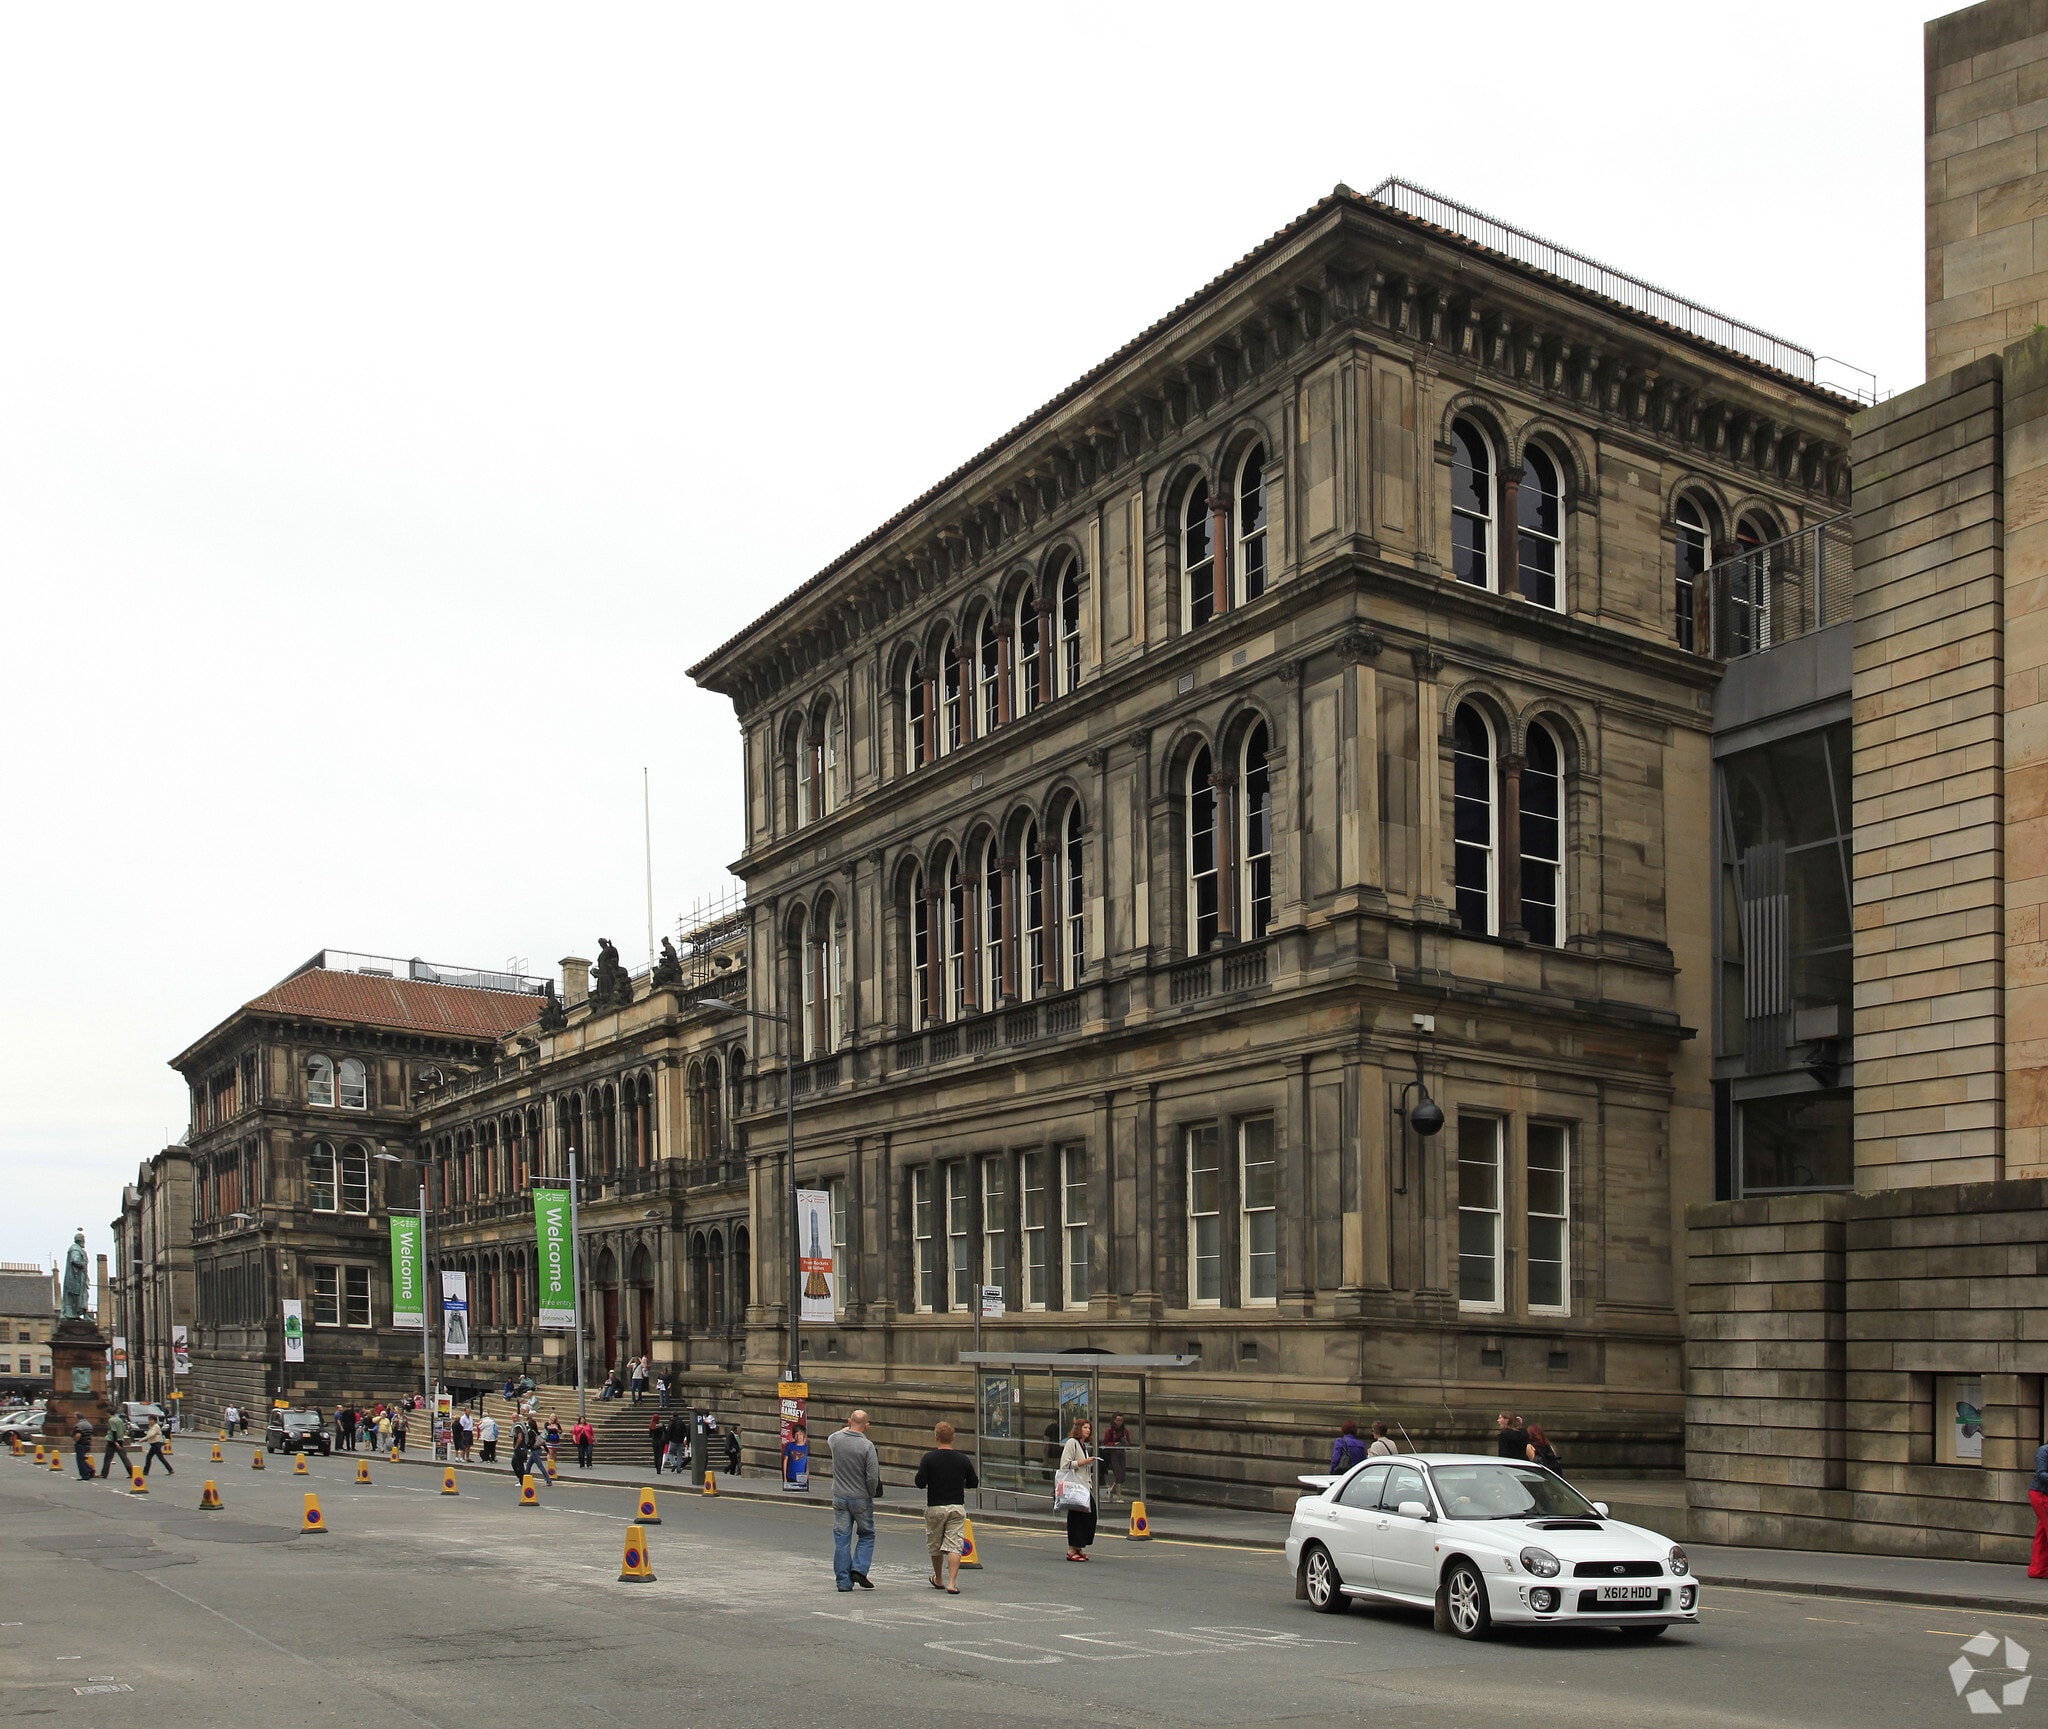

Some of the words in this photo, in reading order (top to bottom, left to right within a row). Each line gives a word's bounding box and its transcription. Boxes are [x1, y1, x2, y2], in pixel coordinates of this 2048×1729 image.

[546, 1207, 564, 1292] Welcome
[400, 1231, 415, 1299] Welcome
[541, 1298, 555, 1306] Free
[556, 1300, 572, 1308] entry
[782, 1399, 798, 1409] CHRIS
[781, 1406, 805, 1418] RAMSEY
[697, 1415, 703, 1423] P
[1604, 1587, 1628, 1599] X612
[1631, 1587, 1652, 1598] HDO
[810, 1602, 1098, 1630] KEEP
[924, 1626, 1359, 1665] CLEAR
